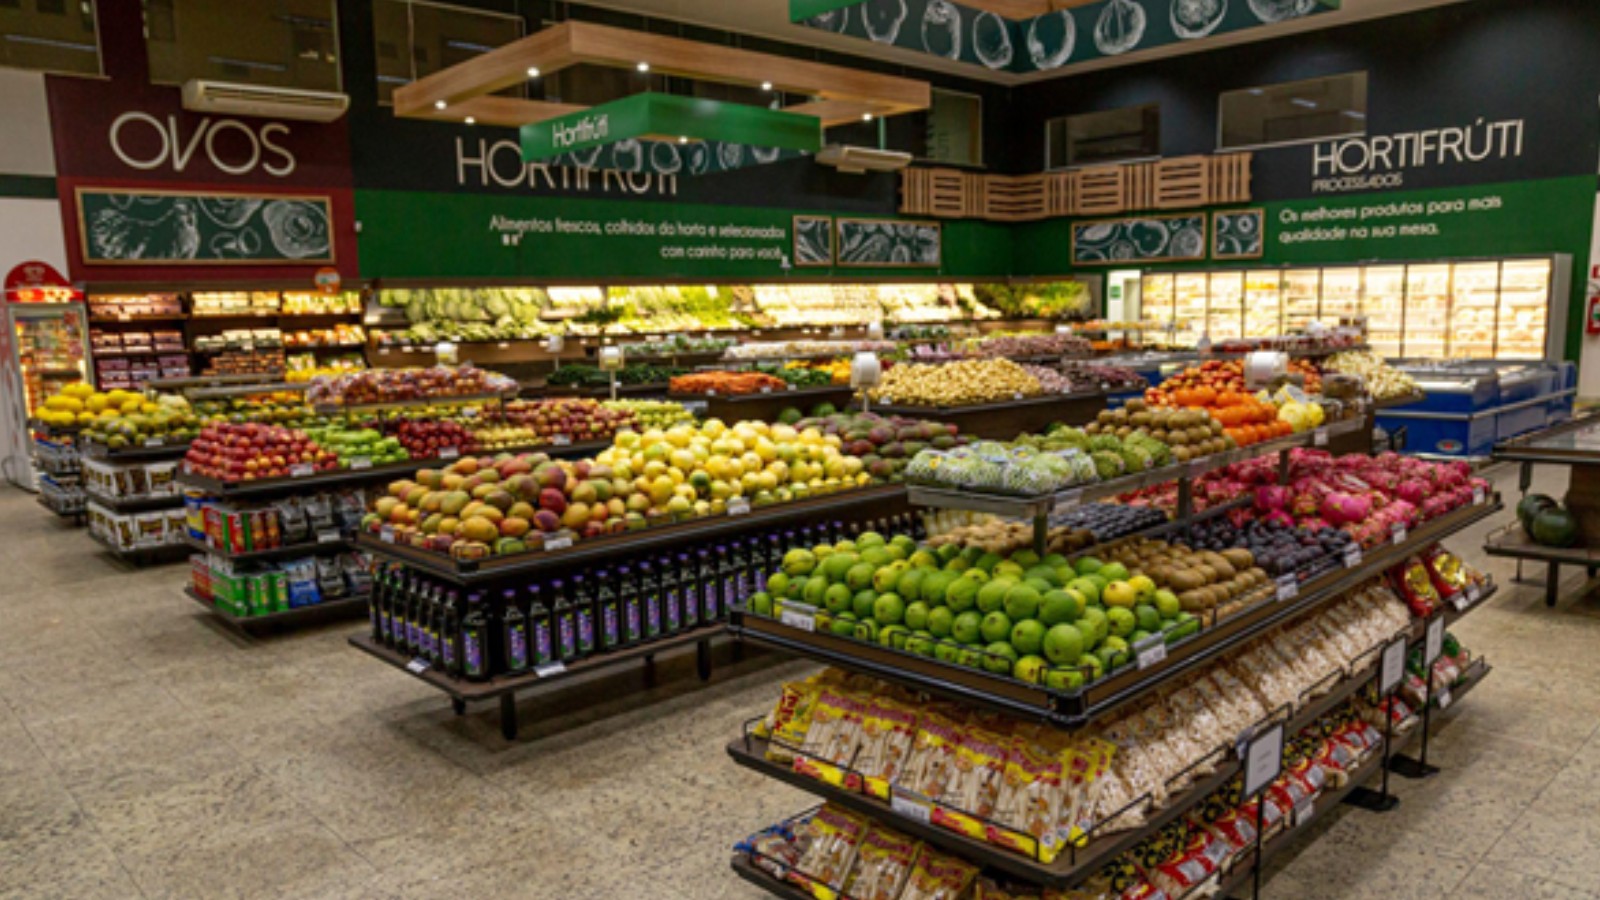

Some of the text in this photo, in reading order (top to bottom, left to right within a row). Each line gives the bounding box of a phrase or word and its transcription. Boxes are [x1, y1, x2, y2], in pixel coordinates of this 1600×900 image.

[109, 111, 296, 177] OVOS
[1312, 117, 1524, 176] HORTIFRÚTI
[1279, 196, 1502, 223] Os melhores produtos para mais
[1279, 225, 1346, 244] qualidade
[1350, 226, 1368, 239] na
[1372, 224, 1396, 238] sua
